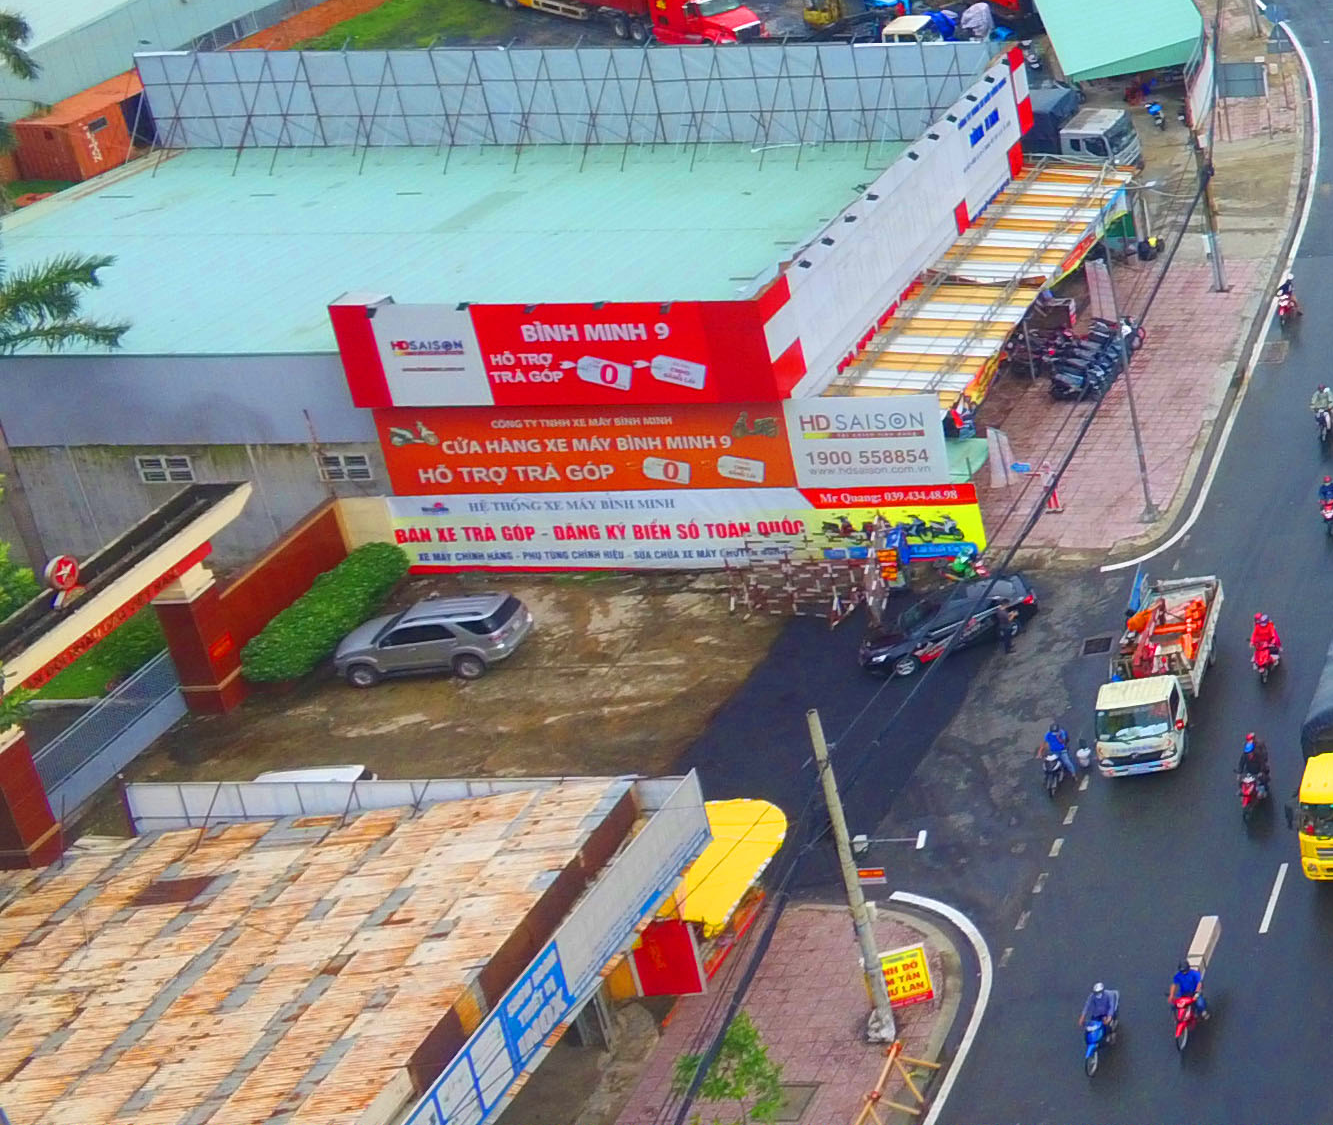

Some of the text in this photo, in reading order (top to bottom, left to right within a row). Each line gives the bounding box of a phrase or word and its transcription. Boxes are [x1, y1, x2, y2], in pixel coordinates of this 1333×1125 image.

[520, 322, 670, 342] BÌNH MINH 9
[489, 351, 553, 367] HỖ TRỢ
[489, 368, 564, 385] TRẢ GÓP
[600, 364, 618, 384] 0
[524, 418, 537, 428] TY
[539, 418, 571, 428] TNHH
[571, 418, 587, 427] XE
[588, 416, 613, 427] MÁY
[613, 415, 641, 426] BÌNH
[643, 416, 673, 426] MINH
[441, 432, 732, 455] CỬA HÀNG XE MÁY BÌNH MINH 9
[805, 448, 929, 465] 1900 558854
[418, 460, 615, 485] HỖ TRỢ TRẢ GÓP
[808, 464, 931, 476] www.hdsaison.com.vn
[819, 493, 838, 504] Mr
[884, 489, 958, 502] 039.434.48.98
[468, 496, 675, 516] HỆ THỐNG XE MÁY BÌNH MINH
[394, 527, 432, 544] BÁN
[437, 528, 456, 542] XE
[462, 522, 497, 542] TRẢ
[501, 524, 536, 541] GÓP
[553, 523, 600, 540] ĐĂNG
[606, 519, 628, 540] KÝ
[632, 518, 670, 540] BIỂN
[677, 517, 700, 540] SỐ
[706, 519, 751, 539] TOÀN
[418, 553, 431, 562] XE
[433, 551, 453, 562] MÁY
[455, 551, 485, 561] CHÍNH
[549, 550, 570, 561] TÙNG
[571, 550, 601, 560] CHÍNH
[603, 550, 624, 561] HIỆU
[682, 549, 694, 558] XE
[696, 548, 717, 559] MÁY
[902, 981, 925, 994] LAN
